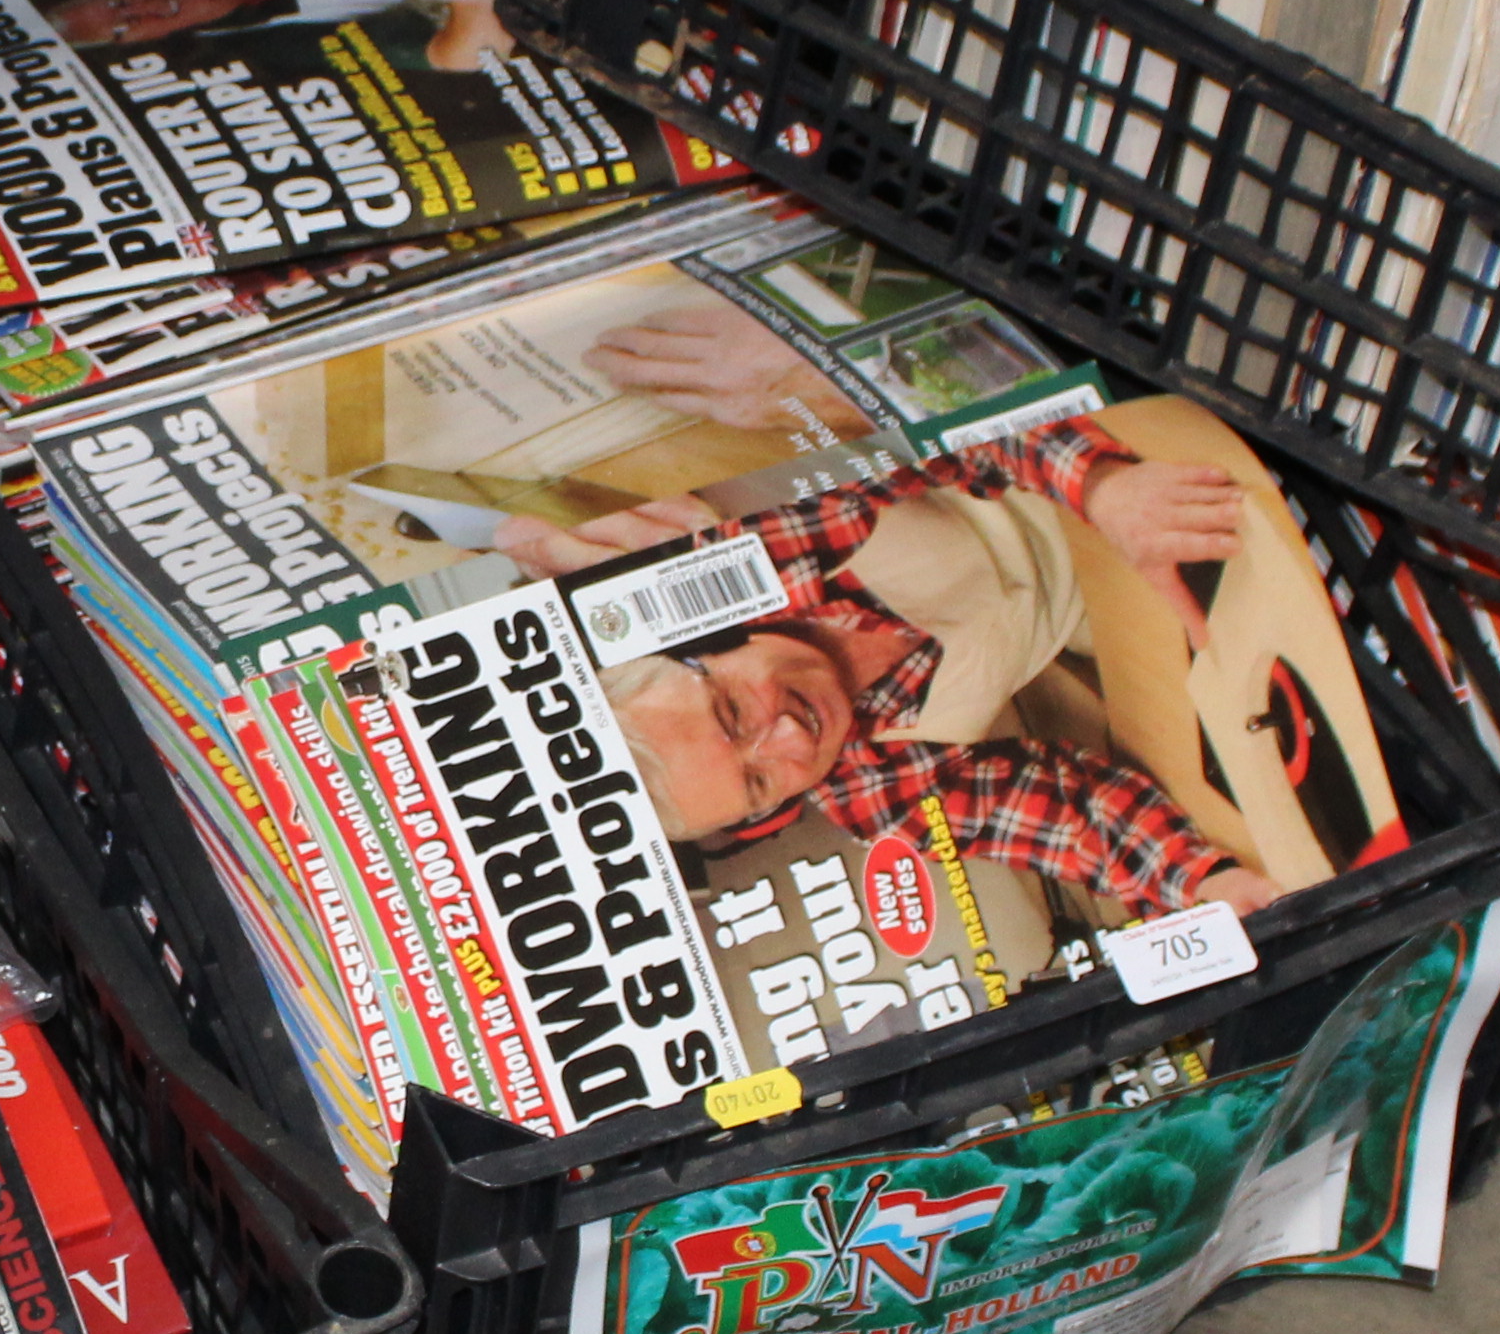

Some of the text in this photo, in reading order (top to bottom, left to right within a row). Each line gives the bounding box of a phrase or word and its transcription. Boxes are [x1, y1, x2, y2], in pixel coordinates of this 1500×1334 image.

[27, 103, 100, 143] &
[62, 131, 182, 269] Plans
[103, 46, 296, 258] ROUTER JIG
[187, 57, 359, 244] TO SHAPE
[268, 72, 427, 232] CURVES
[493, 140, 563, 201] PLUS
[147, 405, 358, 587] Projects
[285, 698, 448, 1025] technical skills
[477, 604, 677, 957] Projects
[913, 791, 991, 951] masterclass
[373, 738, 547, 1118] Triton kit PLUS £2,000 of Trend
[392, 625, 654, 1132] DWORKING
[646, 836, 730, 1040] www.woodworkersinstitute.com
[787, 849, 916, 1035] your
[861, 855, 937, 936] New series
[1151, 931, 1209, 968] 705
[712, 1079, 781, 1116] 20140
